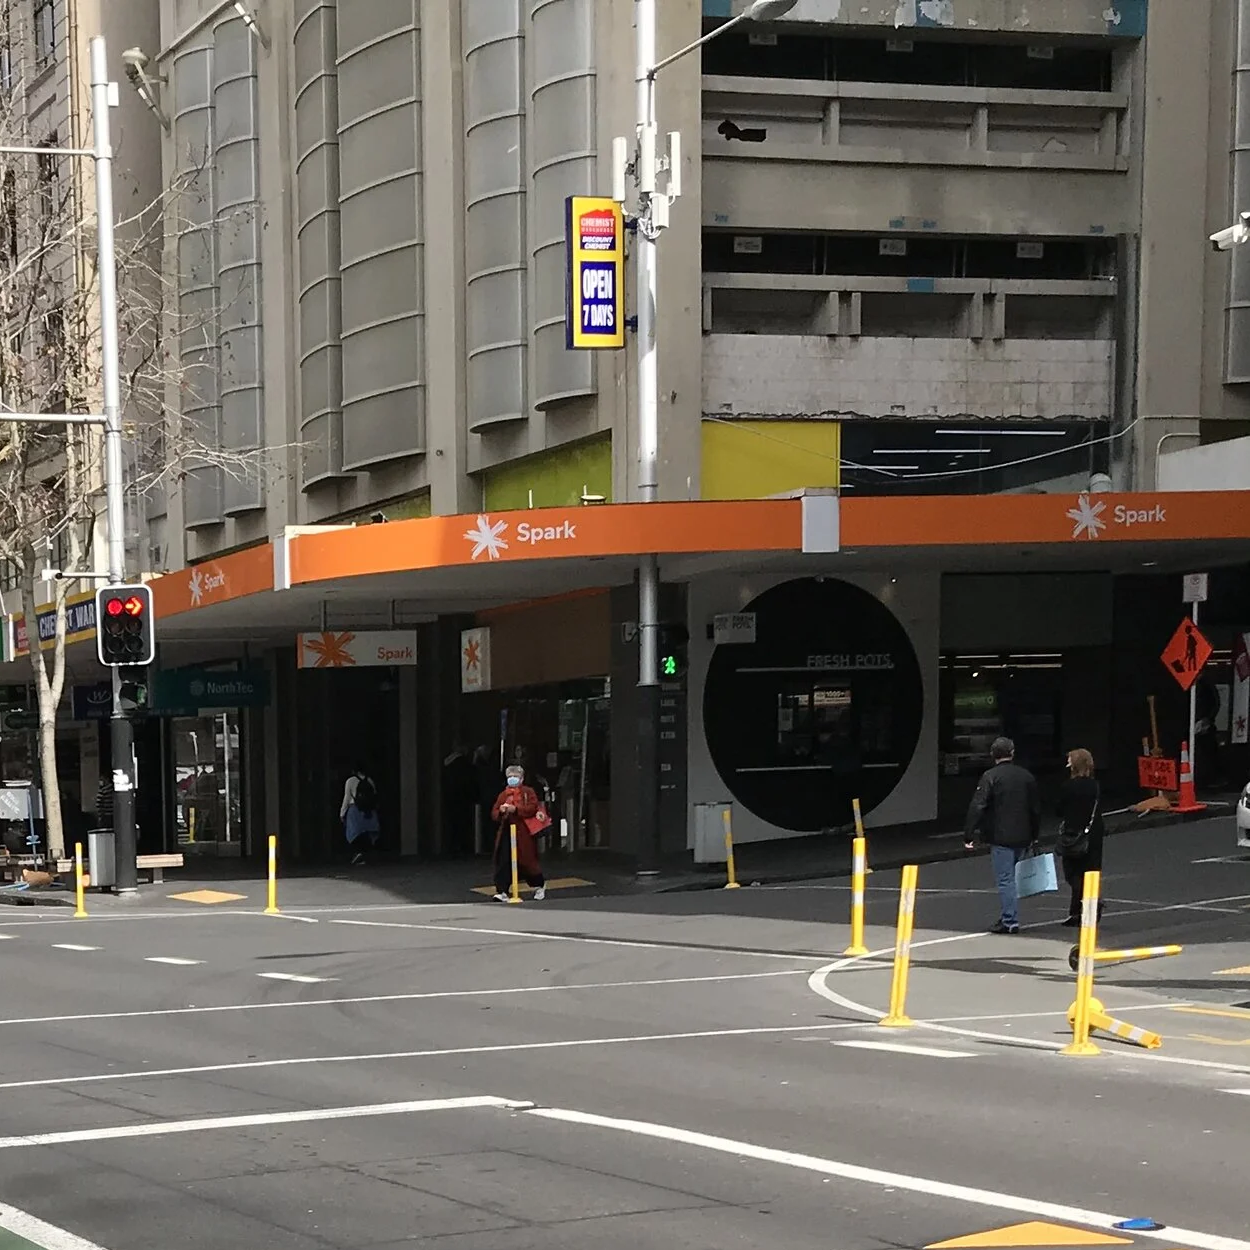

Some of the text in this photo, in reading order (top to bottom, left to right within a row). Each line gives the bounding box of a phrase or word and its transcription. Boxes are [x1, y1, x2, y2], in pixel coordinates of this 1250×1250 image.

[581, 218, 615, 227] CHEMIST
[583, 269, 613, 299] OPEN
[583, 304, 614, 327] 7 DAYS
[1114, 504, 1167, 527] Spark
[517, 520, 577, 545] Spark
[205, 569, 225, 592] Spark
[377, 647, 413, 661] Spark
[807, 653, 891, 667] FRESH POTS
